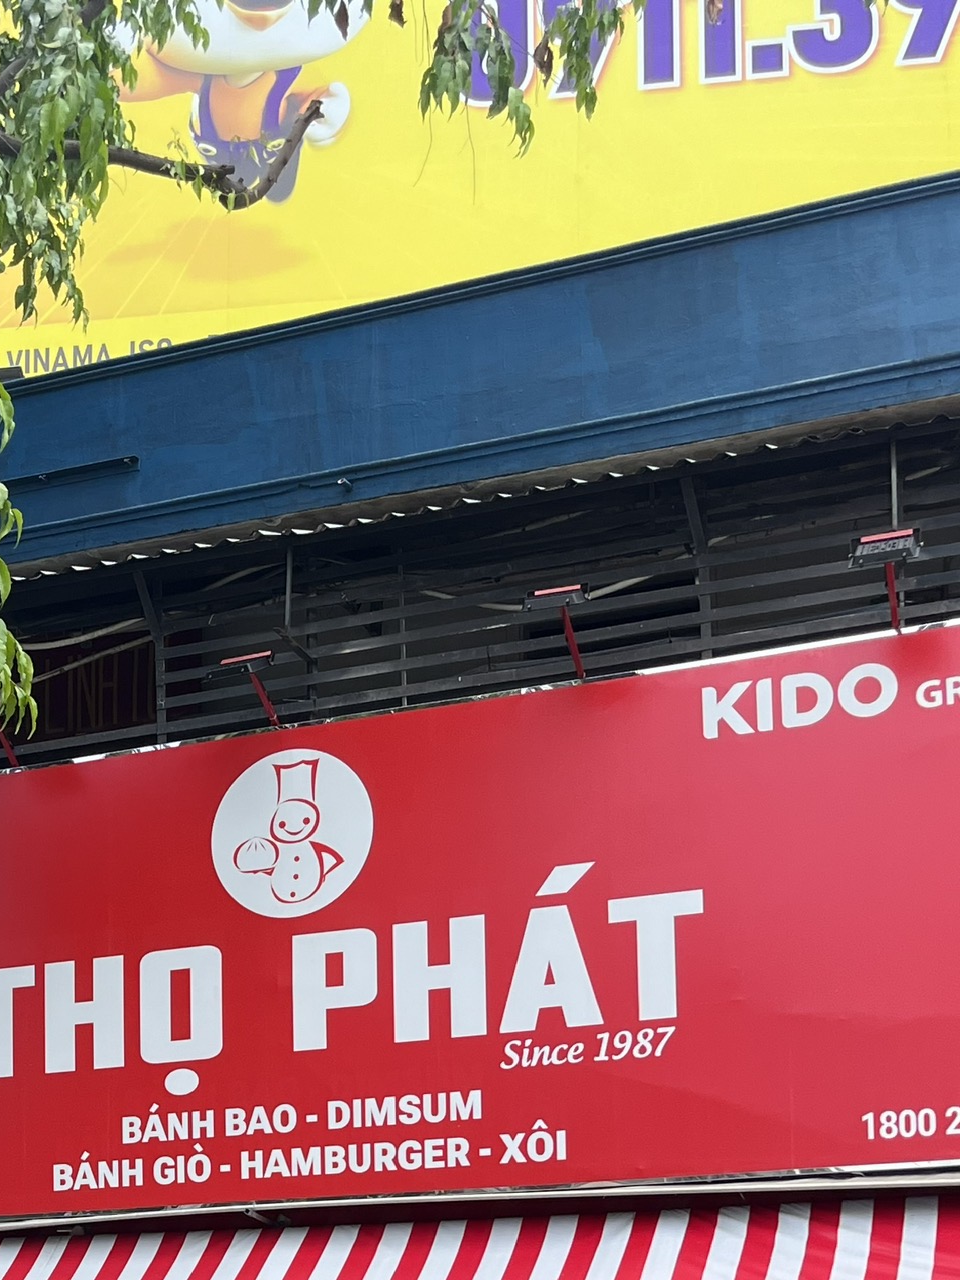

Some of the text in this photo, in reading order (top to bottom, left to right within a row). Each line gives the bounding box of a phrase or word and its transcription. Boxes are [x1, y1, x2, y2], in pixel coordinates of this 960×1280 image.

[7, 343, 110, 374] VINAMA
[701, 663, 898, 740] KIDO
[292, 861, 704, 1052] PHÁT
[499, 1026, 677, 1070] Since 1987
[121, 1104, 215, 1146] BÁNH
[225, 1104, 298, 1137] BAO
[327, 1090, 483, 1132] DIMSUM
[861, 1108, 937, 1140] 1800
[52, 1151, 143, 1192] BÁNH
[153, 1145, 212, 1185] GIÒ
[240, 1136, 471, 1181] HAMBURGER
[499, 1119, 568, 1165] XÔI
